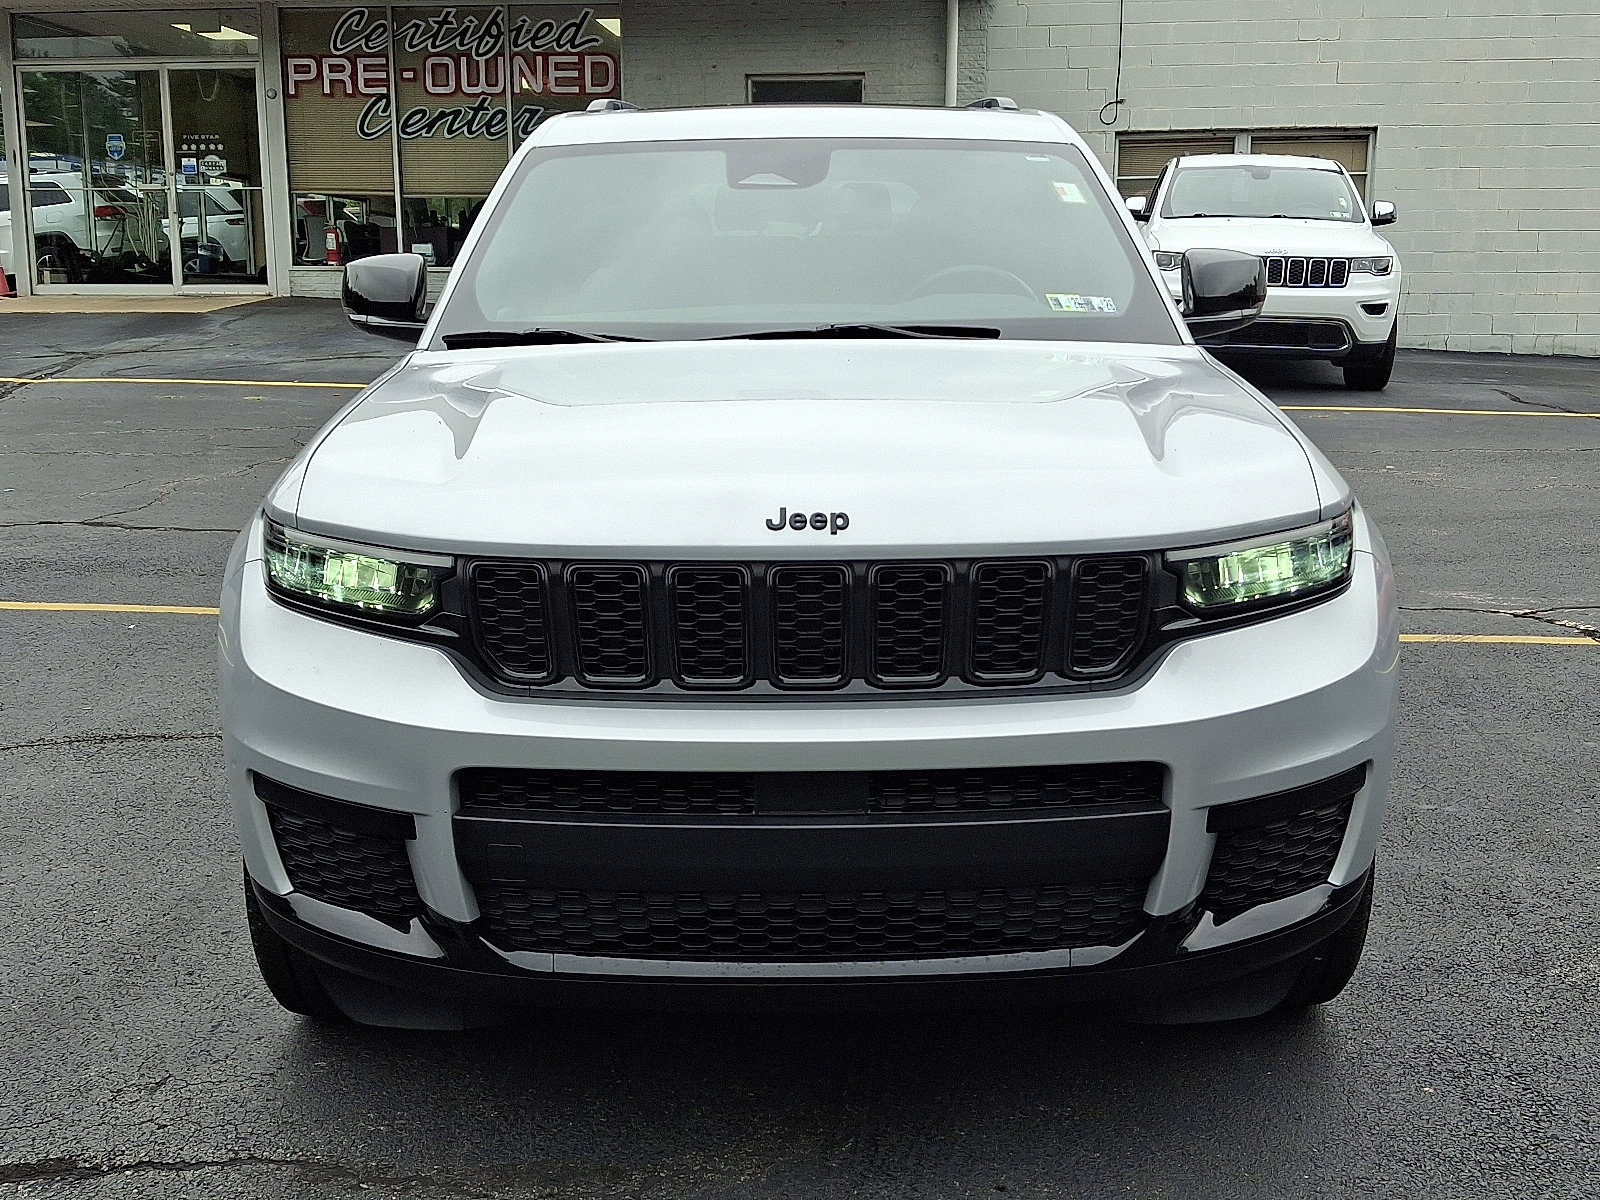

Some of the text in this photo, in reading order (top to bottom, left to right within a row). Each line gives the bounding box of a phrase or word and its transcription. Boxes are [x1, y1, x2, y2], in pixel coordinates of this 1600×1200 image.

[330, 7, 603, 60] Certified
[284, 53, 617, 97] PRE-OWNED
[356, 95, 545, 140] Center
[765, 506, 850, 535] Jeep
